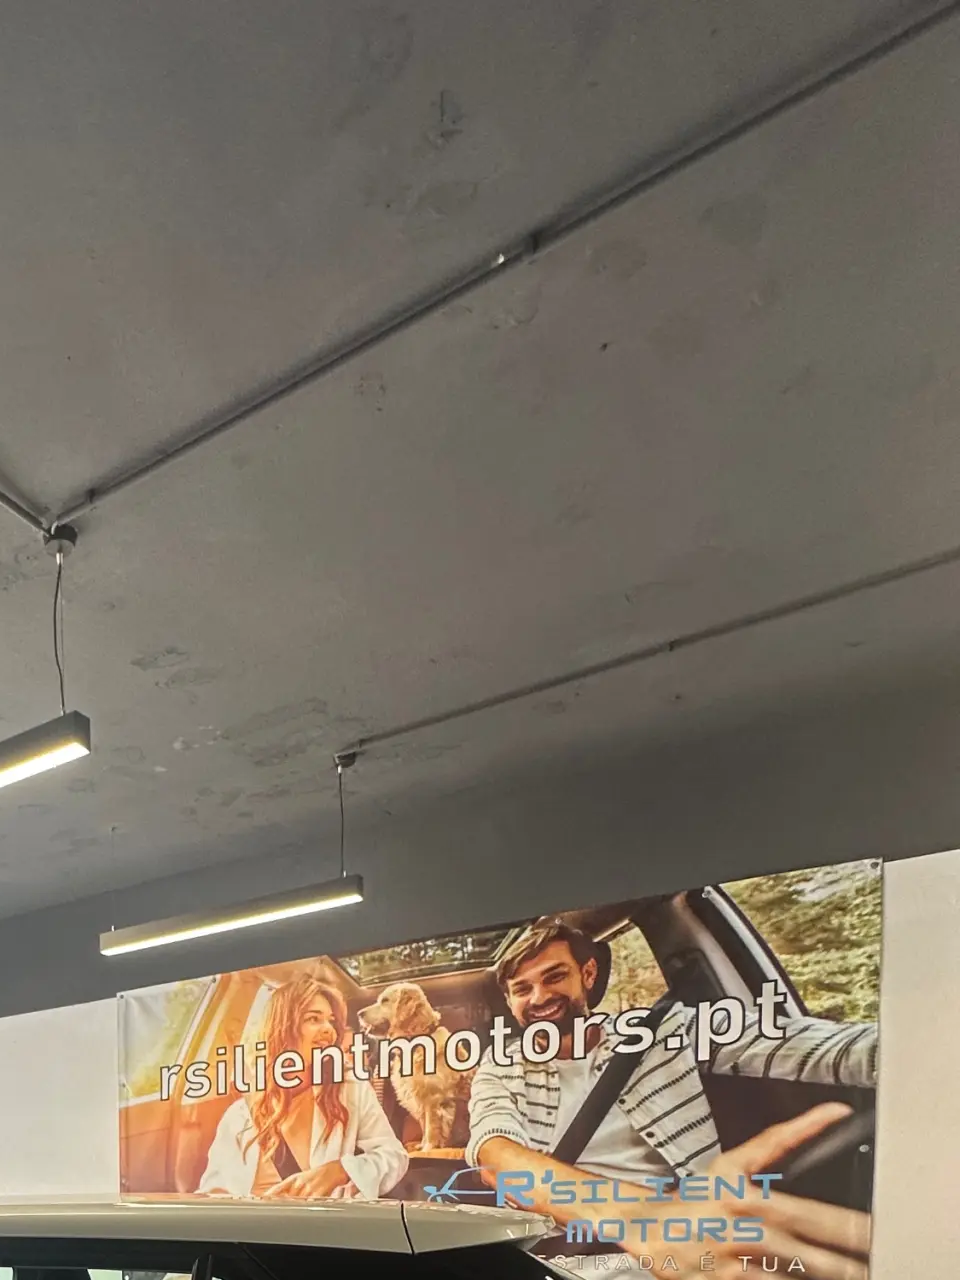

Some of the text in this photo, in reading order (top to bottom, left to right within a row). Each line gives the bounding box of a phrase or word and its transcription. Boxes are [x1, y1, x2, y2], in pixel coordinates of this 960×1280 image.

[159, 979, 788, 1101] rsilientmotors.pt
[496, 1168, 783, 1207] R'SILIENT
[566, 1217, 764, 1243] MOTORS
[538, 1250, 807, 1273] STRADA É TUA
